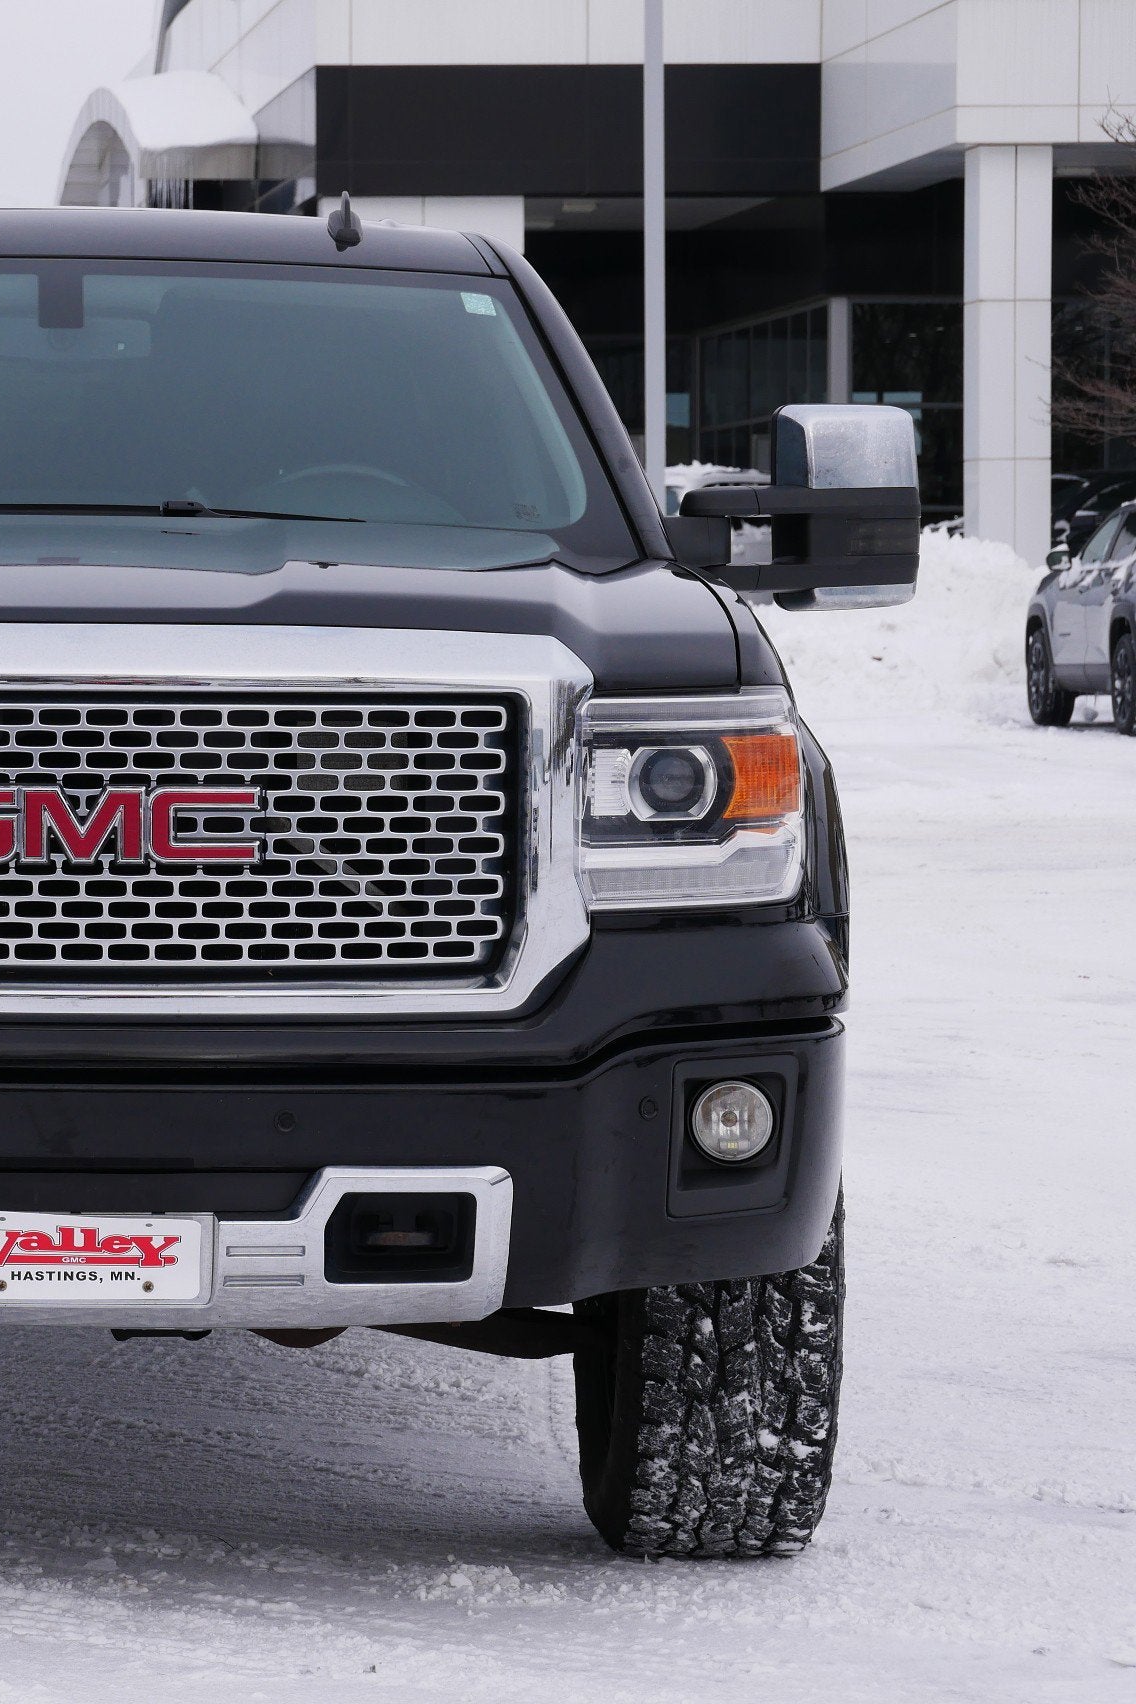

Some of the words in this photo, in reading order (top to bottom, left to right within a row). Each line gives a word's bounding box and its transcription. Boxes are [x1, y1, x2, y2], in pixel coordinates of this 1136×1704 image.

[61, 1256, 87, 1264] GMC
[10, 1270, 104, 1283] HASTINGS,
[110, 1271, 141, 1281] MN.
